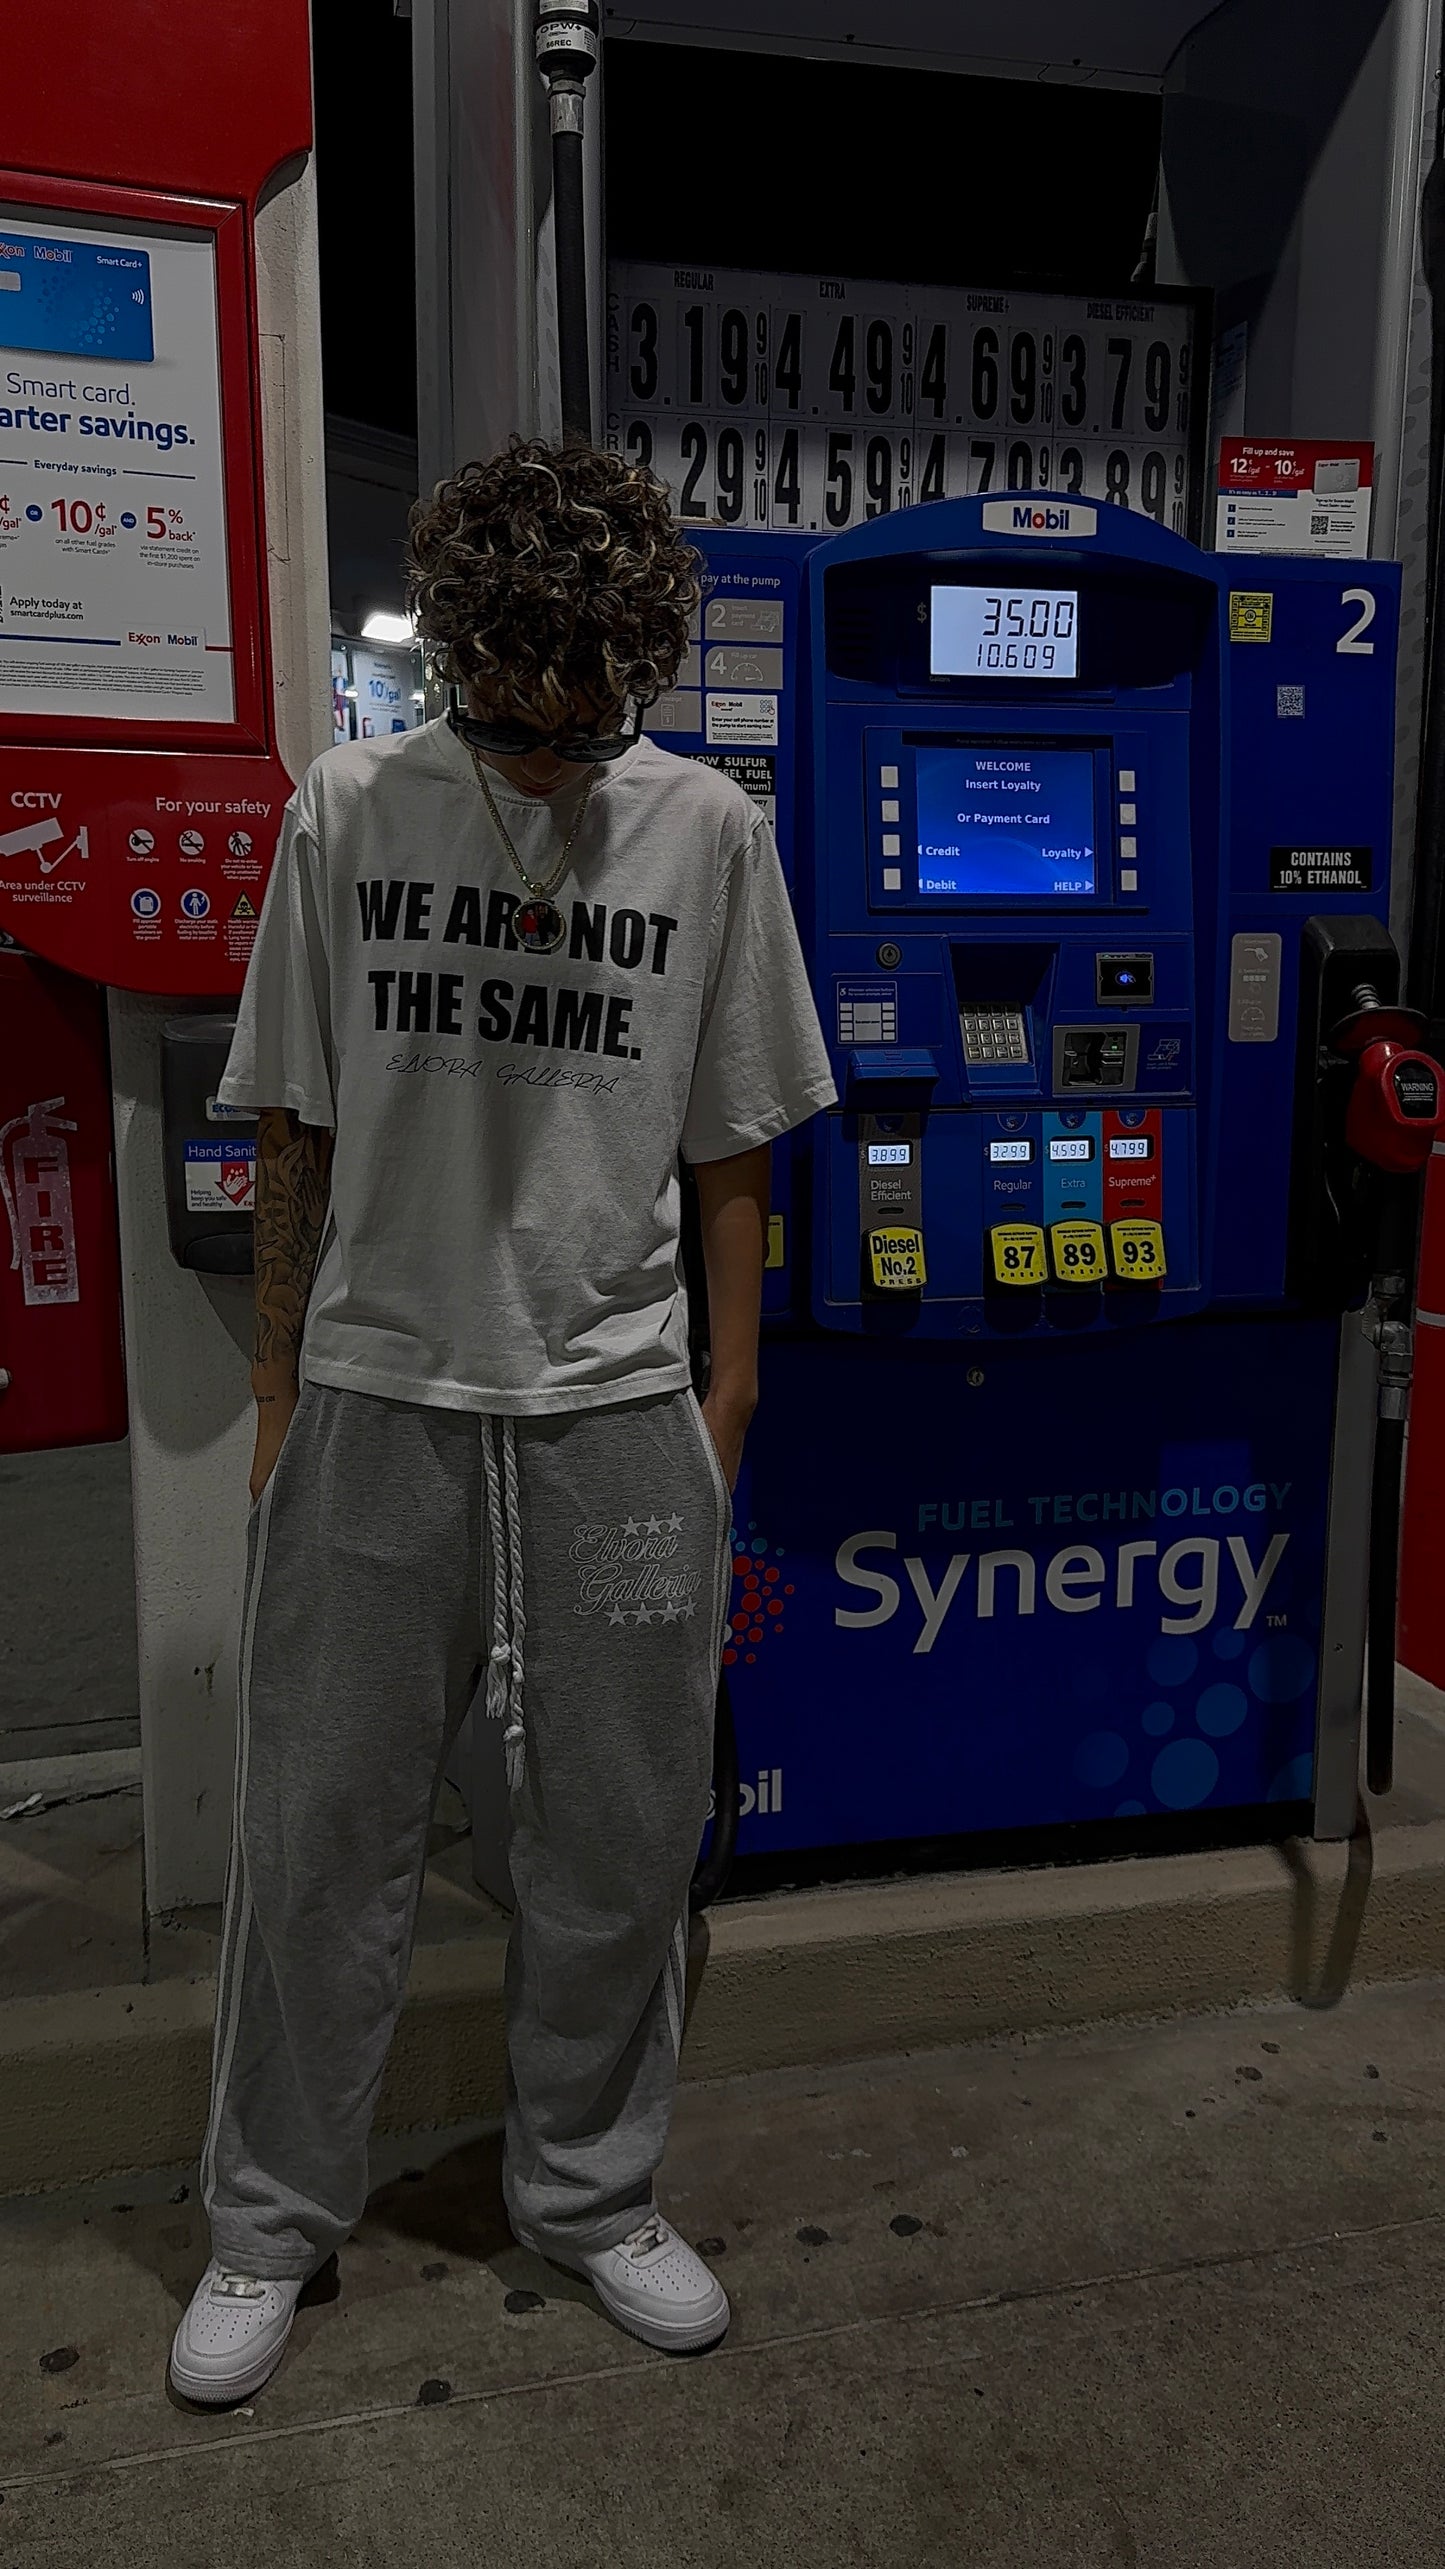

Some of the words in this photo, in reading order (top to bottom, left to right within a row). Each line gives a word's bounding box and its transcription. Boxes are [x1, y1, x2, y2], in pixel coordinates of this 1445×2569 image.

[34, 245, 72, 263] Mobil
[96, 256, 119, 267] Smart
[674, 270, 714, 291] REGULAR
[819, 281, 846, 300] EXTRA
[1087, 302, 1113, 321] DIESEL
[1115, 303, 1155, 322] EFFICIENT
[7, 373, 77, 400] Smart
[83, 383, 136, 406] card.
[0, 406, 71, 434] arter
[79, 412, 196, 450] savings.
[1265, 448, 1278, 456] and
[34, 460, 79, 474] Everyday
[81, 463, 117, 476] savings
[1013, 507, 1070, 530] Mobil
[701, 574, 718, 588] pay
[721, 574, 731, 584] at
[733, 574, 749, 584] the
[751, 577, 781, 588] pump
[10, 597, 39, 610] Apply
[42, 598, 70, 611] today
[72, 600, 82, 610] at
[10, 609, 84, 620] smartcardplus.com
[711, 604, 726, 628] 2
[982, 598, 1074, 638] 35.00
[1336, 588, 1376, 655] 2
[128, 632, 160, 646] Exxon
[168, 634, 198, 646] Mobil
[710, 652, 727, 675] 4
[977, 644, 1055, 669] 10.609
[724, 757, 768, 767] SULFUR
[975, 761, 1032, 772] WELCOME
[746, 770, 773, 779] FUEL
[965, 780, 998, 790] Insert
[1001, 780, 1041, 792] Loyalty
[10, 791, 62, 809] CCTV
[156, 797, 181, 812] For
[182, 801, 222, 816] your
[224, 799, 272, 818] safety
[957, 812, 971, 823] Or
[974, 813, 1022, 826] Payment
[1024, 813, 1050, 824] Card
[925, 846, 960, 857] Credit
[1042, 847, 1082, 860] Loyalty
[1290, 852, 1352, 867] CONTAINS
[926, 880, 957, 890] Debit
[1280, 870, 1302, 885] 10%
[1307, 870, 1362, 885] ETHANOL
[0, 881, 22, 890] Area
[24, 881, 55, 891] under
[57, 881, 86, 891] CCTV
[1054, 881, 1082, 891] HELP
[12, 892, 73, 902] surveillance
[356, 880, 435, 942] WE
[568, 901, 678, 975] NOT
[367, 970, 464, 1035] THE
[477, 978, 642, 1061] SAME.
[1401, 1083, 1434, 1091] WARNING
[188, 1145, 222, 1158] Hand
[225, 1145, 257, 1157] Sanit
[871, 1179, 902, 1190] Diesel
[994, 1179, 1032, 1193] Regular
[1061, 1178, 1086, 1188] Extra
[871, 1191, 912, 1200] Efficient
[872, 1234, 920, 1254] Diesel
[1004, 1245, 1035, 1269] 87
[1063, 1243, 1096, 1266] 89
[1122, 1241, 1155, 1264] 93
[1061, 1267, 1103, 1275] PRESS
[916, 1498, 1013, 1534] FUEL
[1027, 1482, 1294, 1525] TECHNOLOGY
[573, 1562, 702, 1616] Galleria
[834, 1531, 1292, 1654] Synergy
